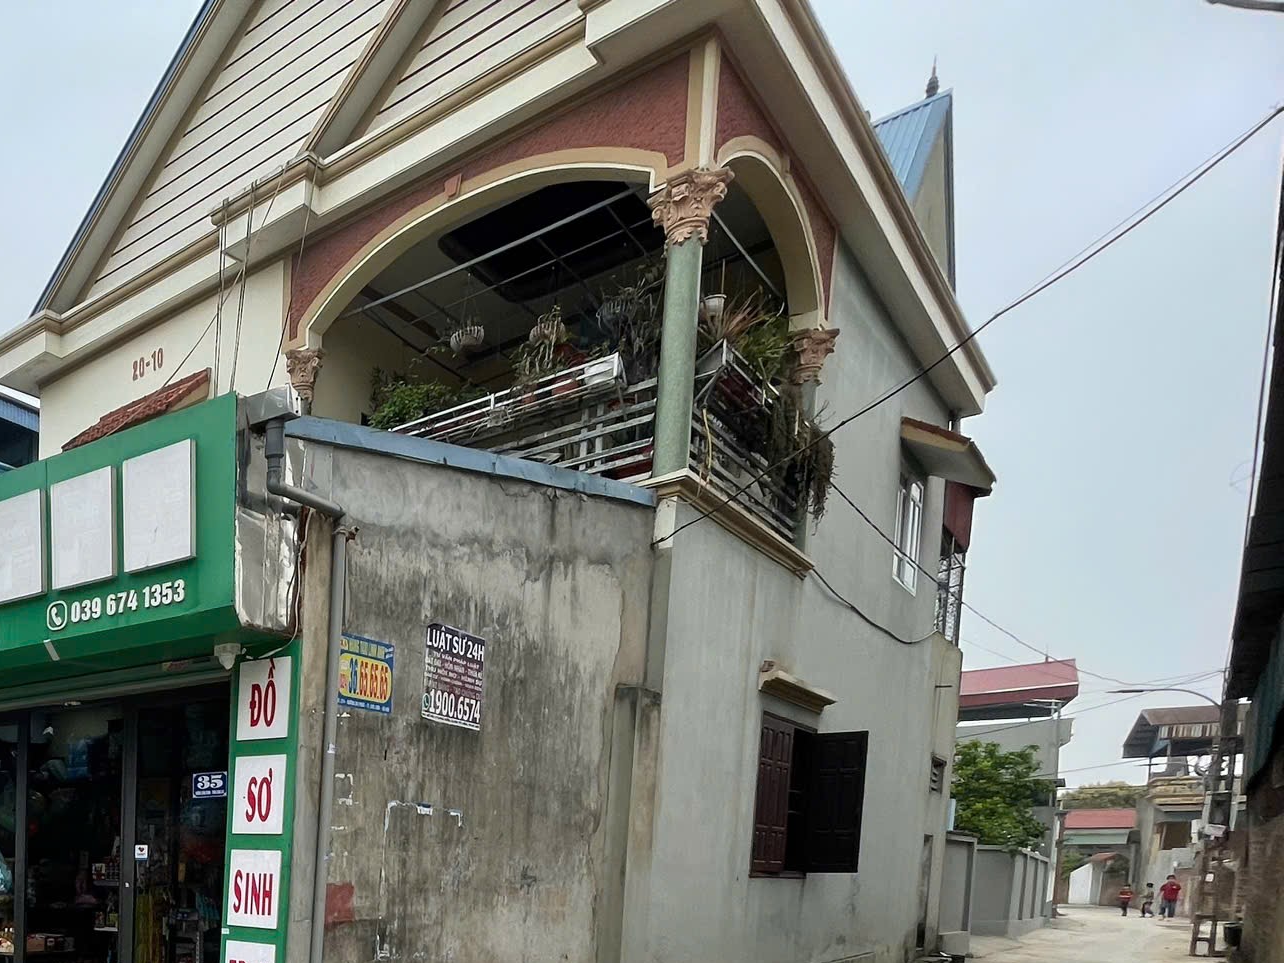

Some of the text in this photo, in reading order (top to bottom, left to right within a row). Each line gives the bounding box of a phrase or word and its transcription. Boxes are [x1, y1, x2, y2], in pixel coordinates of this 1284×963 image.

[132, 347, 163, 381] 20-10
[70, 579, 185, 623] 039 674 1353
[426, 625, 484, 661] LUẬT SƯ 24H
[249, 658, 277, 728] ĐỒ
[429, 688, 481, 723] 1900.6574
[196, 774, 224, 790] 35
[245, 767, 274, 823] SƠ
[233, 869, 273, 917] SINH
